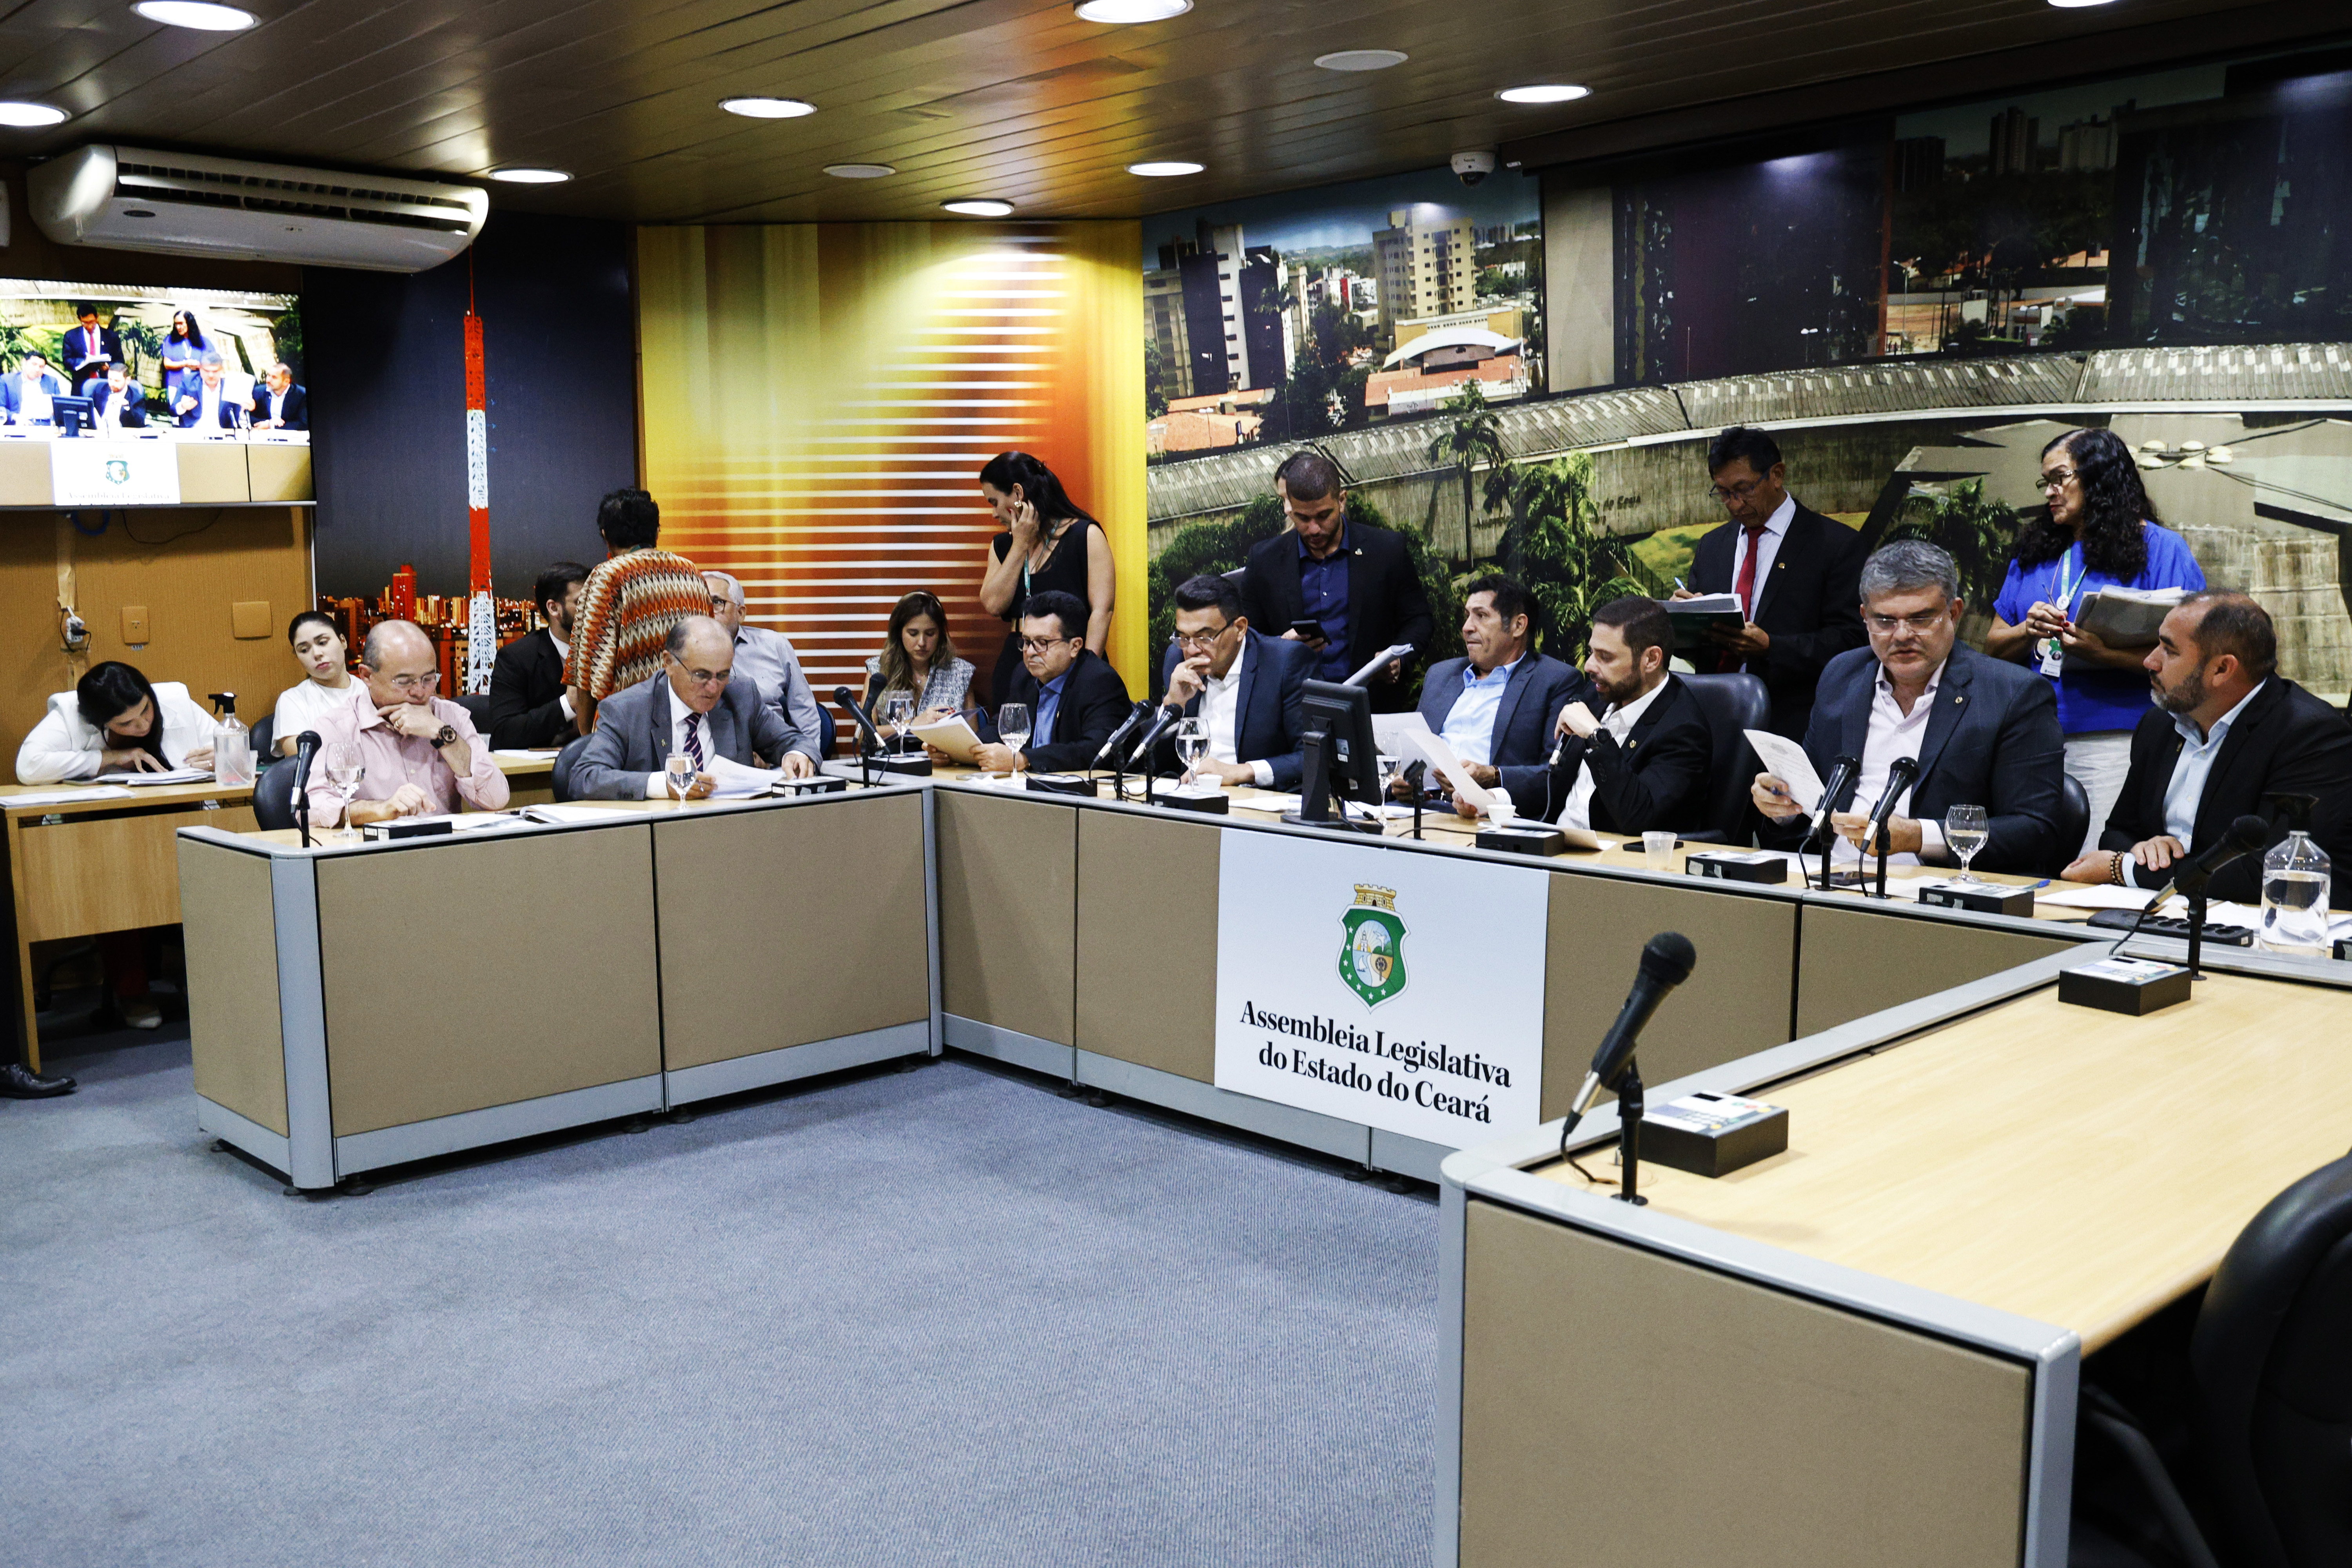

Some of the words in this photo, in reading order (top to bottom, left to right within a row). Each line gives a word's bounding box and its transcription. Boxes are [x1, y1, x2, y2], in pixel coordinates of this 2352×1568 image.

[1240, 1000, 1371, 1054] Assembleia
[1374, 1031, 1512, 1088] Legislativa
[1259, 1041, 1287, 1070] do
[1292, 1049, 1372, 1092] Estado
[1377, 1071, 1409, 1102] do
[1415, 1081, 1492, 1124] Ceará
